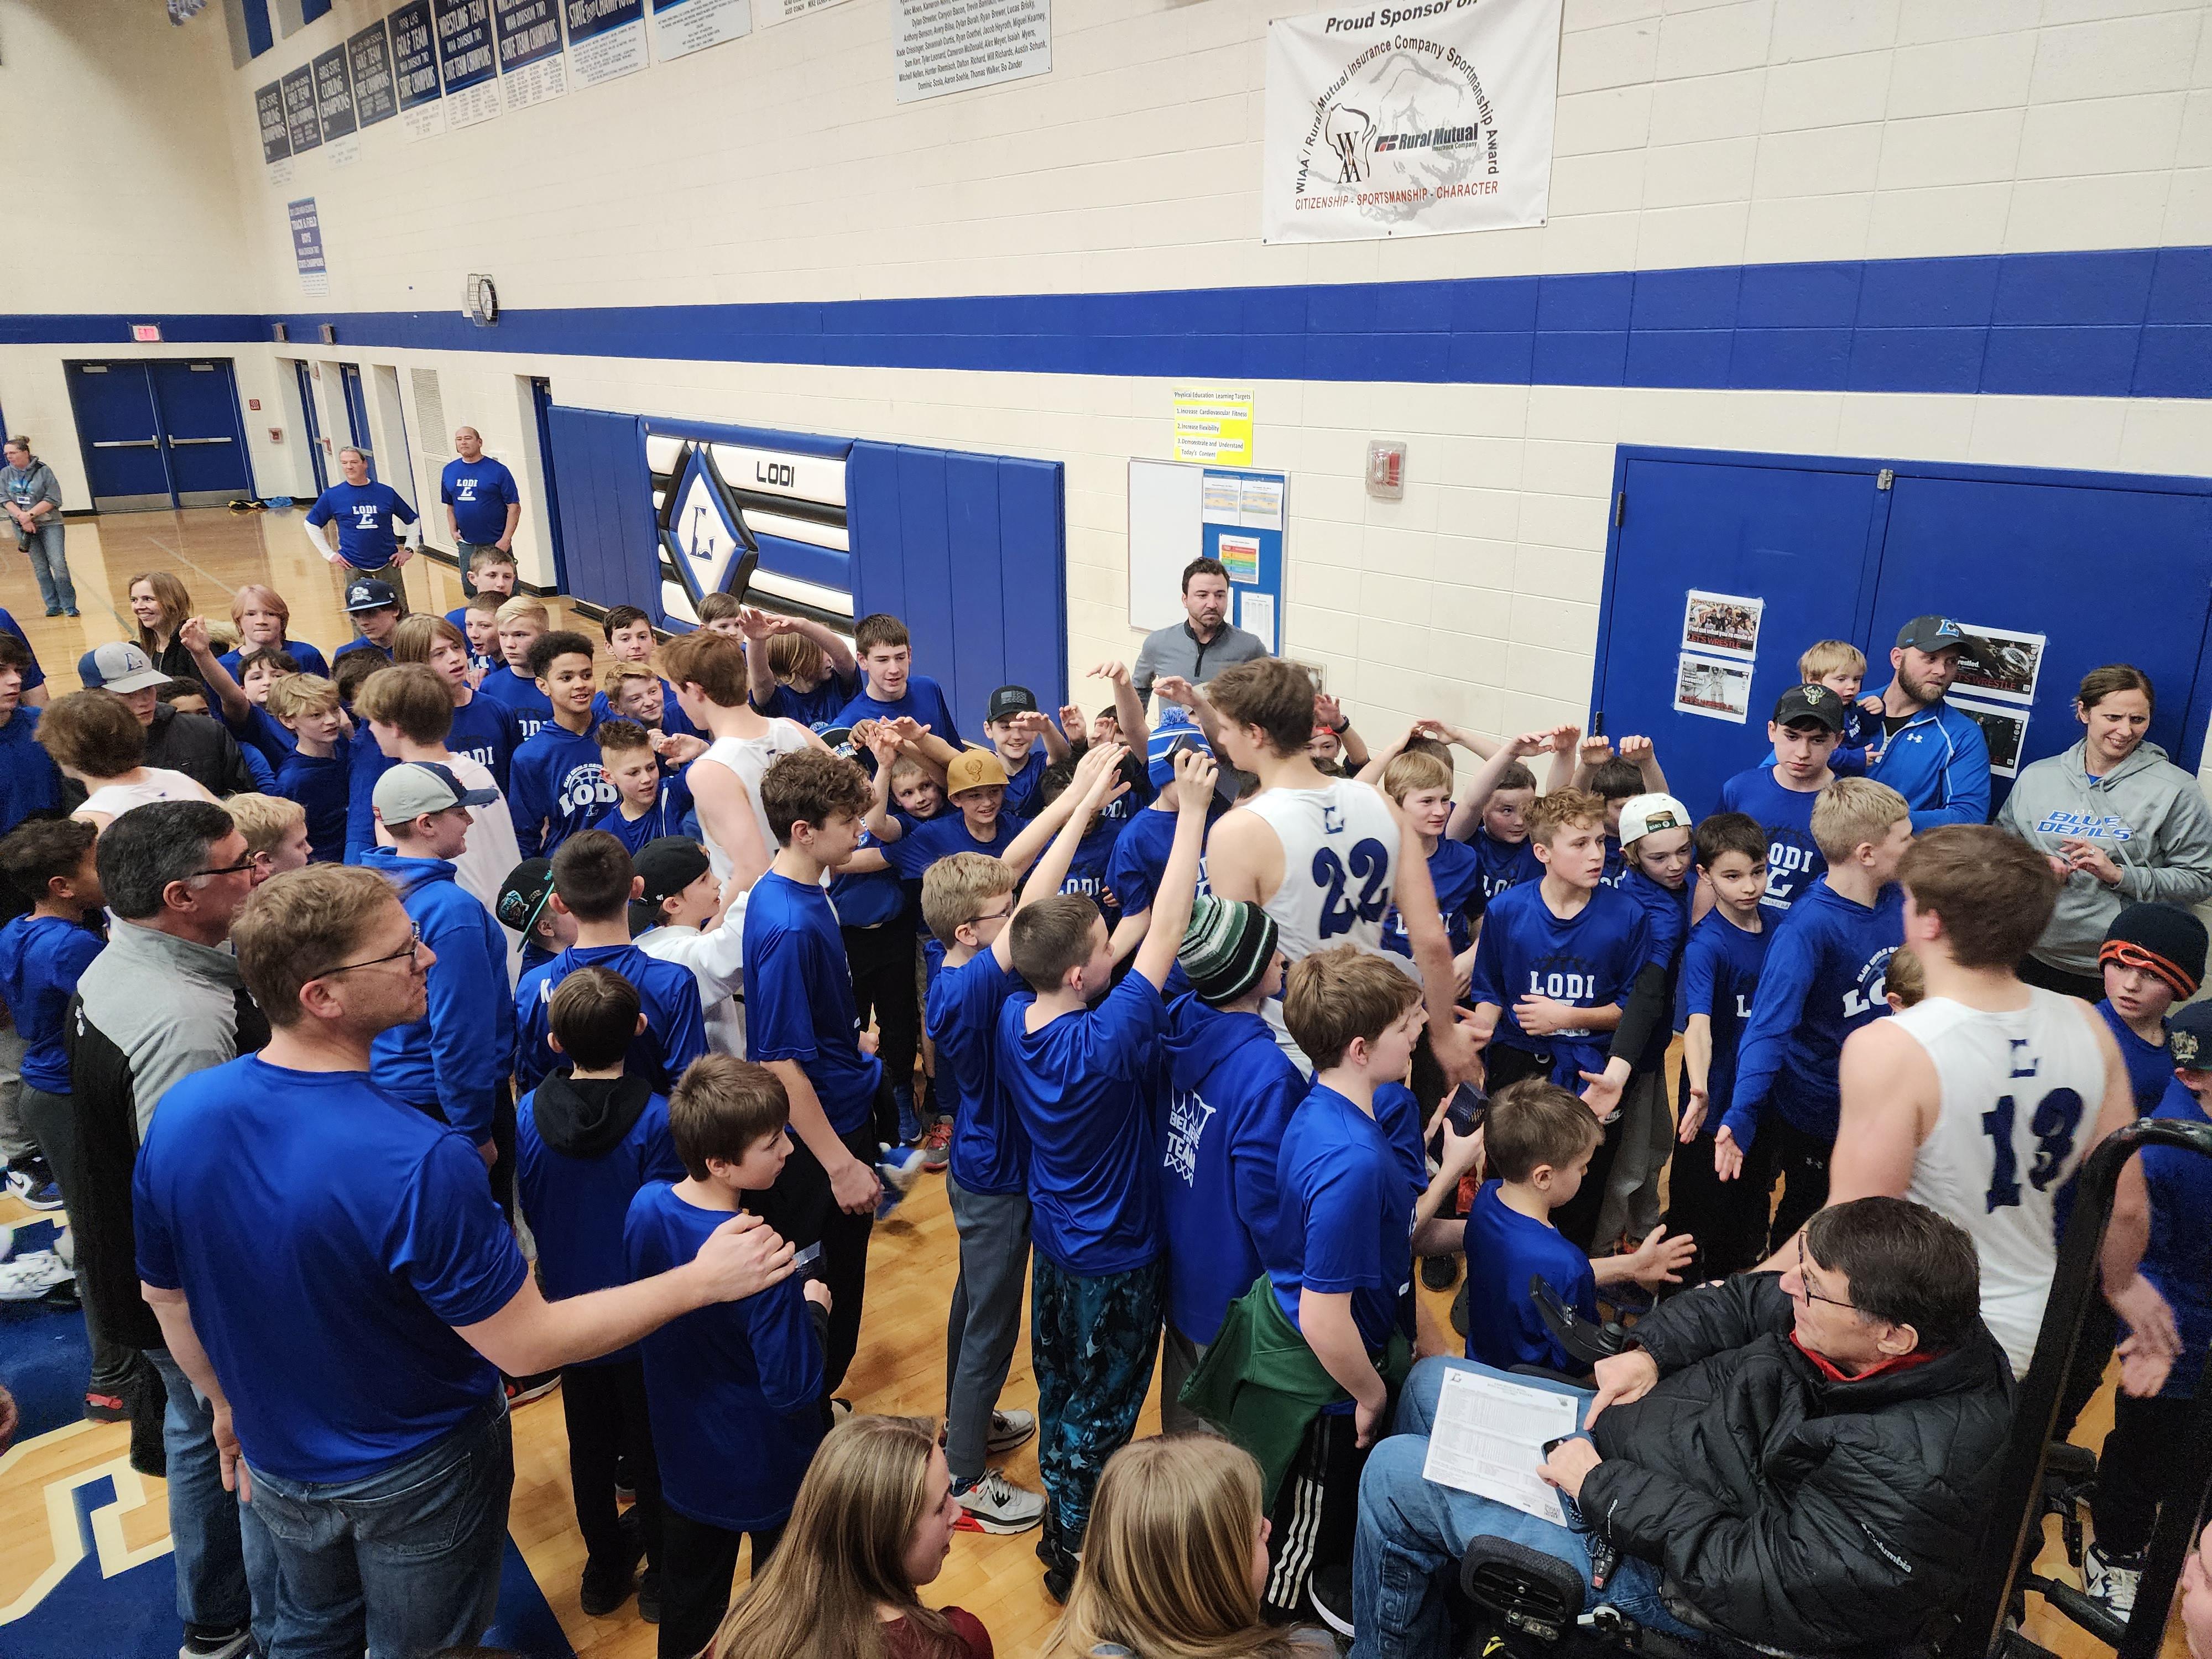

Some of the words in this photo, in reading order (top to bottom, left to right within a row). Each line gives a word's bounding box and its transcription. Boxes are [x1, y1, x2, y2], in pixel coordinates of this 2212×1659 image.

[468, 0, 487, 25] TEAM
[569, 1, 586, 29] STATE
[1007, 4, 1020, 14] Lucas
[1325, 11, 1375, 34] Proud
[1380, 1, 1452, 28] Sponsor
[1013, 15, 1027, 28] Miguel
[984, 39, 993, 48] Alex
[1015, 44, 1028, 55] Austin
[1296, 158, 1309, 195] WIAA
[1306, 110, 1323, 150] Rural
[1317, 70, 1349, 111] Mutual
[1348, 40, 1391, 76] Insurance
[1395, 34, 1444, 60] Company
[1486, 129, 1500, 175] Award
[1399, 129, 1432, 150] Rural
[1432, 122, 1479, 145] Mutual
[1295, 195, 1349, 211] CITIZENSHIP
[1357, 188, 1427, 206] SPORTSMANSHIP
[1436, 181, 1498, 200] CHARACTER
[456, 479, 478, 487] LODI
[757, 461, 795, 488] LODI
[352, 505, 377, 515] LODI
[1708, 637, 1741, 649] WRESTLE
[1957, 659, 1980, 668] restled.
[1973, 677, 2017, 691] WRESTLE
[1649, 823, 1662, 831] BMO
[2048, 810, 2123, 828] BLUE
[2034, 820, 2133, 841] DEVILS
[1769, 842, 1813, 873] ODI
[1313, 837, 1389, 940] 22
[1530, 971, 1595, 999] LODI
[1167, 1131, 1196, 1173] TEAM
